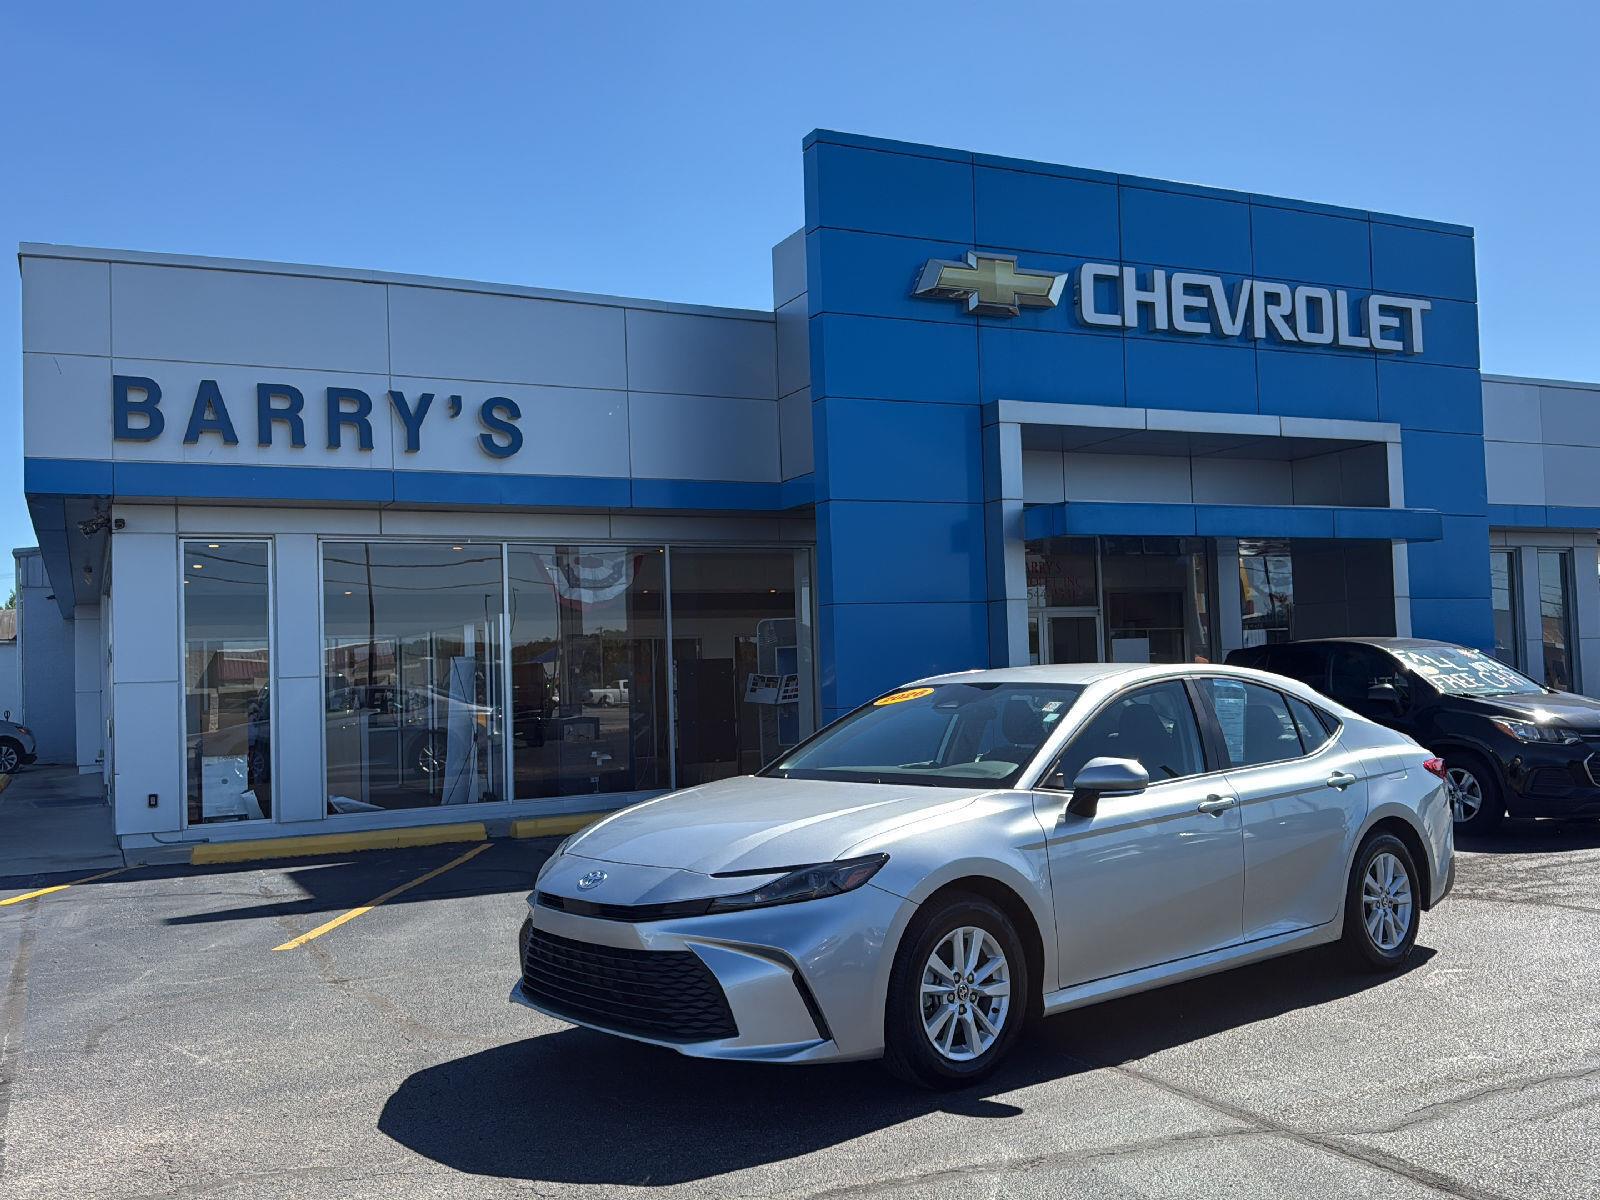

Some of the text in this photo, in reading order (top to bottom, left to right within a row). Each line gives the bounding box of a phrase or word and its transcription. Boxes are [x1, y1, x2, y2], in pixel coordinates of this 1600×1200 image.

[1078, 262, 1431, 354] CHEVROLET
[112, 374, 524, 460] BARRY'S
[1433, 670, 1526, 690] FREE CAR
